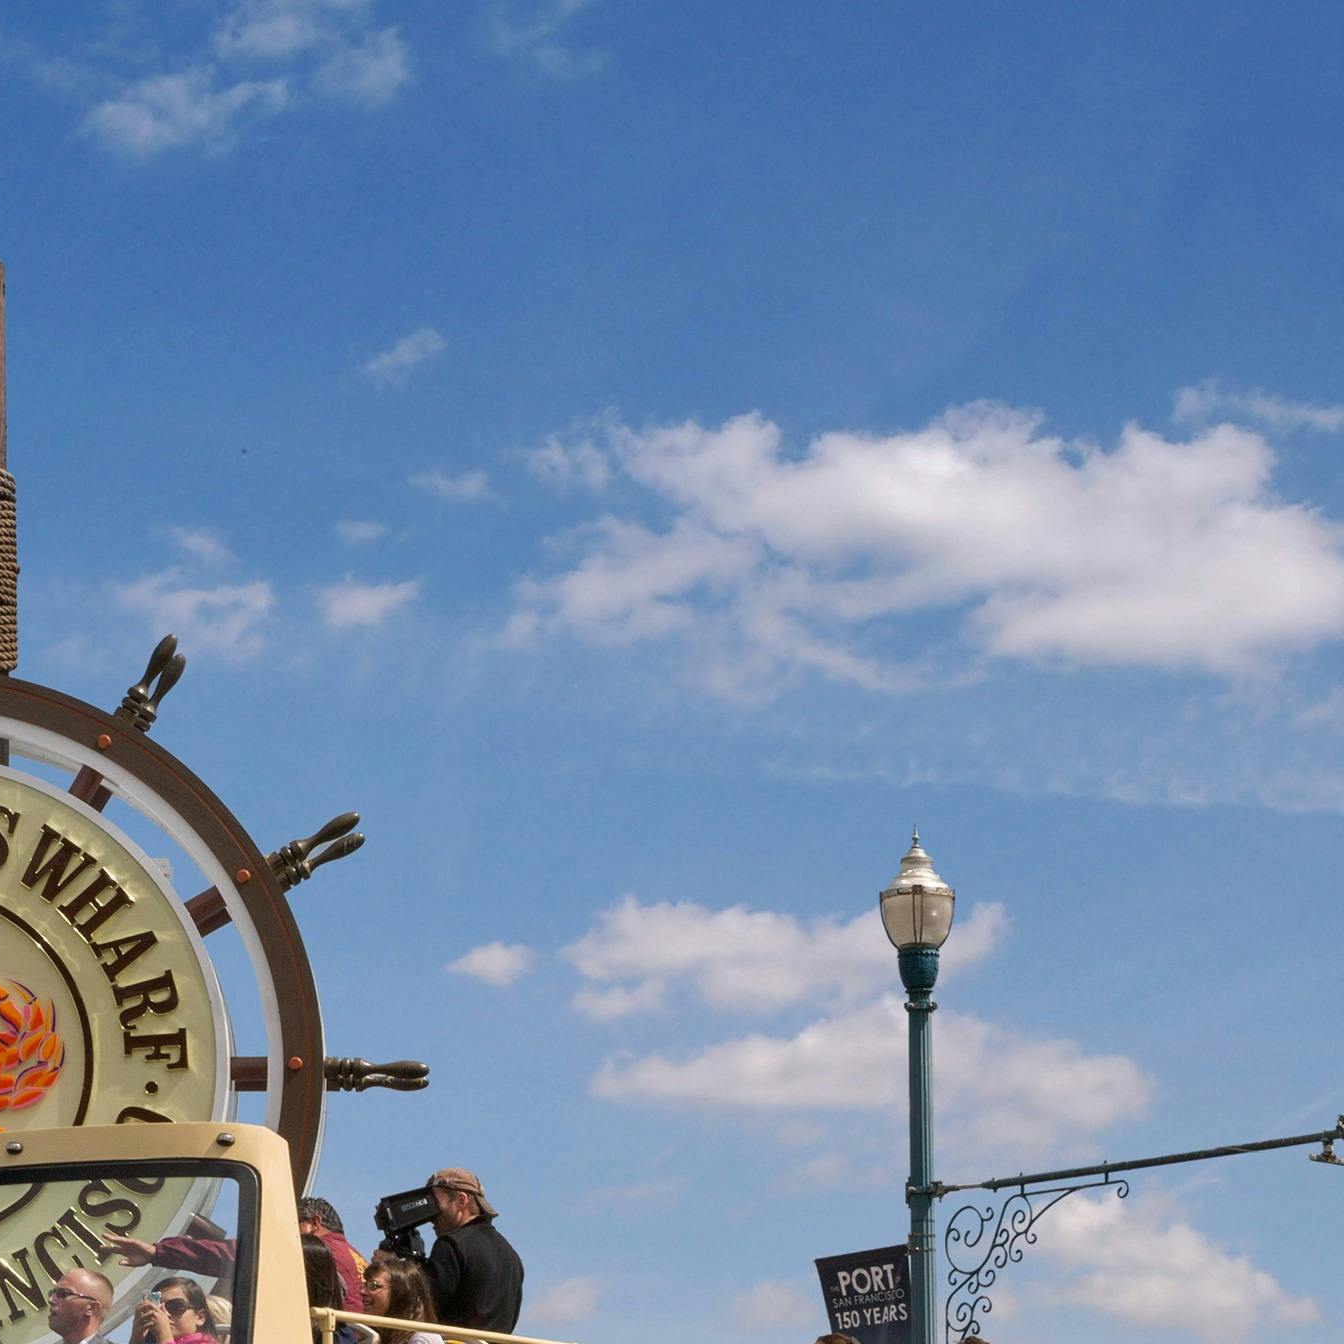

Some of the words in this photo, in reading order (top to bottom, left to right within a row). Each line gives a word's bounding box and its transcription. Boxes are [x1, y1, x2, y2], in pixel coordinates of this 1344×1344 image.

[18, 824, 190, 1073] WHARF
[837, 1264, 894, 1296] PORT
[832, 1297, 852, 1309] SAN
[854, 1288, 905, 1306] FRANCISCO
[835, 1311, 860, 1330] 150
[863, 1303, 908, 1326] YEARS
